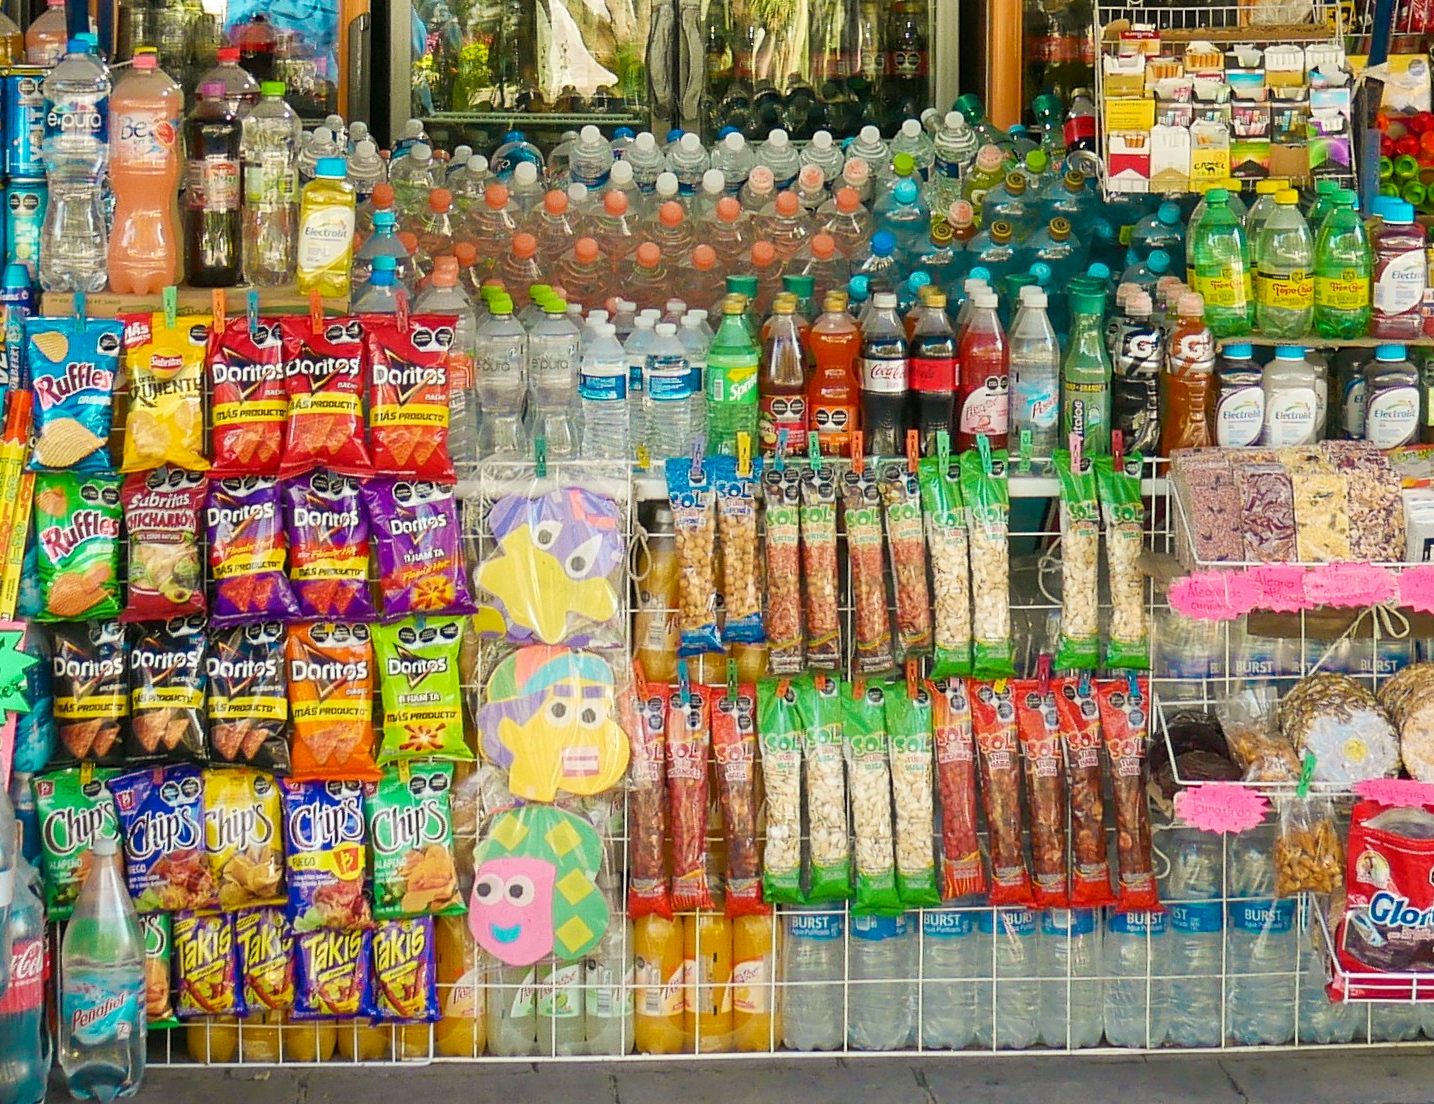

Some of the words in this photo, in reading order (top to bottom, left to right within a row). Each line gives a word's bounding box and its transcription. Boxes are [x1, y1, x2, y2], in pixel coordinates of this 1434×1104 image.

[305, 226, 347, 238] Electrolit
[151, 355, 183, 365] Sabritas
[285, 357, 360, 377] Doritos
[213, 362, 282, 383] Doritos
[372, 365, 446, 385] Doritos
[34, 362, 113, 410] Ruffles
[398, 410, 444, 422] PRODUCTO
[1223, 410, 1261, 420] Electrolit
[1275, 411, 1312, 420] Electrolit
[1374, 409, 1414, 419] Electrolit
[129, 493, 190, 509] Sabritas
[207, 503, 274, 526] Doritos
[294, 508, 359, 528] Doritos
[41, 508, 119, 561] Ruffles
[390, 515, 447, 535] Doritos
[53, 656, 123, 678] Doritos
[131, 649, 199, 670] Doritos
[207, 657, 276, 679] Doritos
[388, 658, 447, 674] Doritos
[1236, 660, 1272, 674] BURST
[291, 661, 368, 680] Doritos
[319, 707, 366, 717] PRODUCTO
[408, 711, 456, 721] PRODUCTO
[715, 745, 753, 763] SOL
[371, 799, 448, 854] Chip's
[792, 916, 829, 928] BURST
[1126, 912, 1164, 926] BURST
[1243, 908, 1283, 923] BURST
[174, 922, 233, 973] Takis
[304, 929, 362, 979] Takis
[372, 926, 426, 978] Takis
